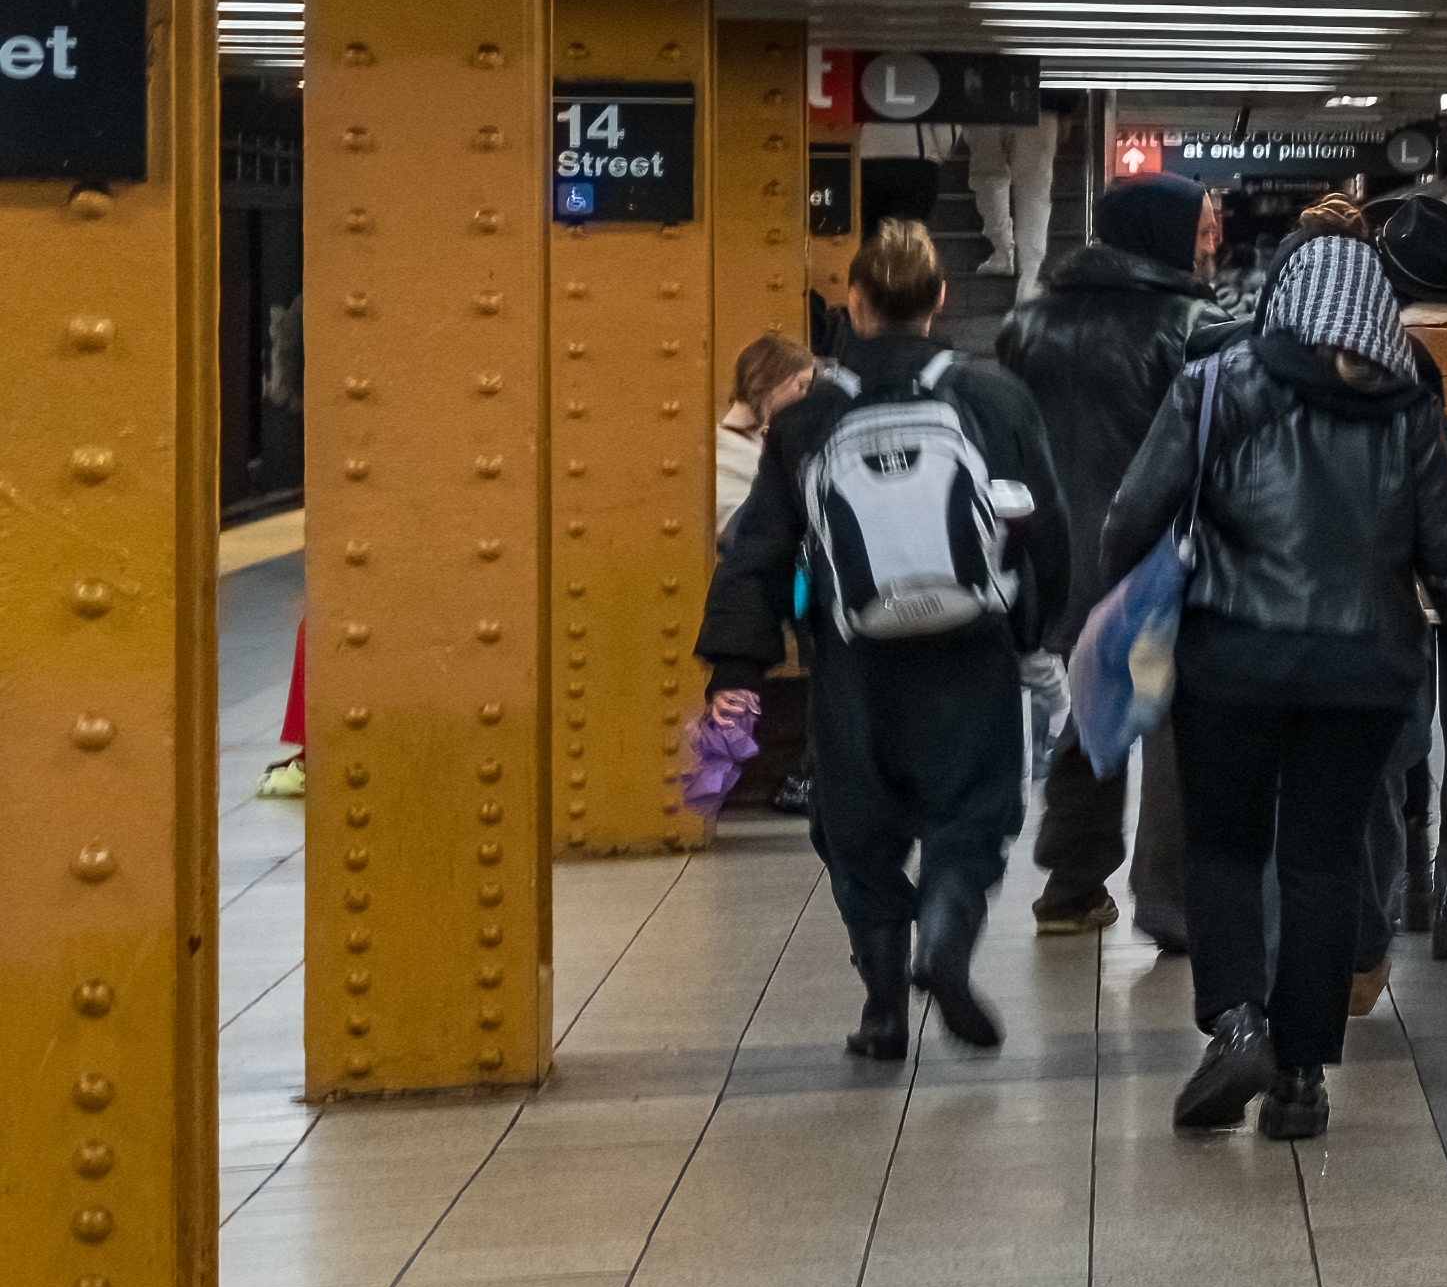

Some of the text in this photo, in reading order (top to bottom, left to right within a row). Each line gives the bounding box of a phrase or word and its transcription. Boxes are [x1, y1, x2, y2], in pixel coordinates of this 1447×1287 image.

[0, 25, 77, 80] et
[885, 65, 916, 105] L
[556, 103, 626, 150] 14
[557, 150, 665, 178] Street
[1183, 141, 1356, 162] at end of platform
[1401, 139, 1421, 164] L
